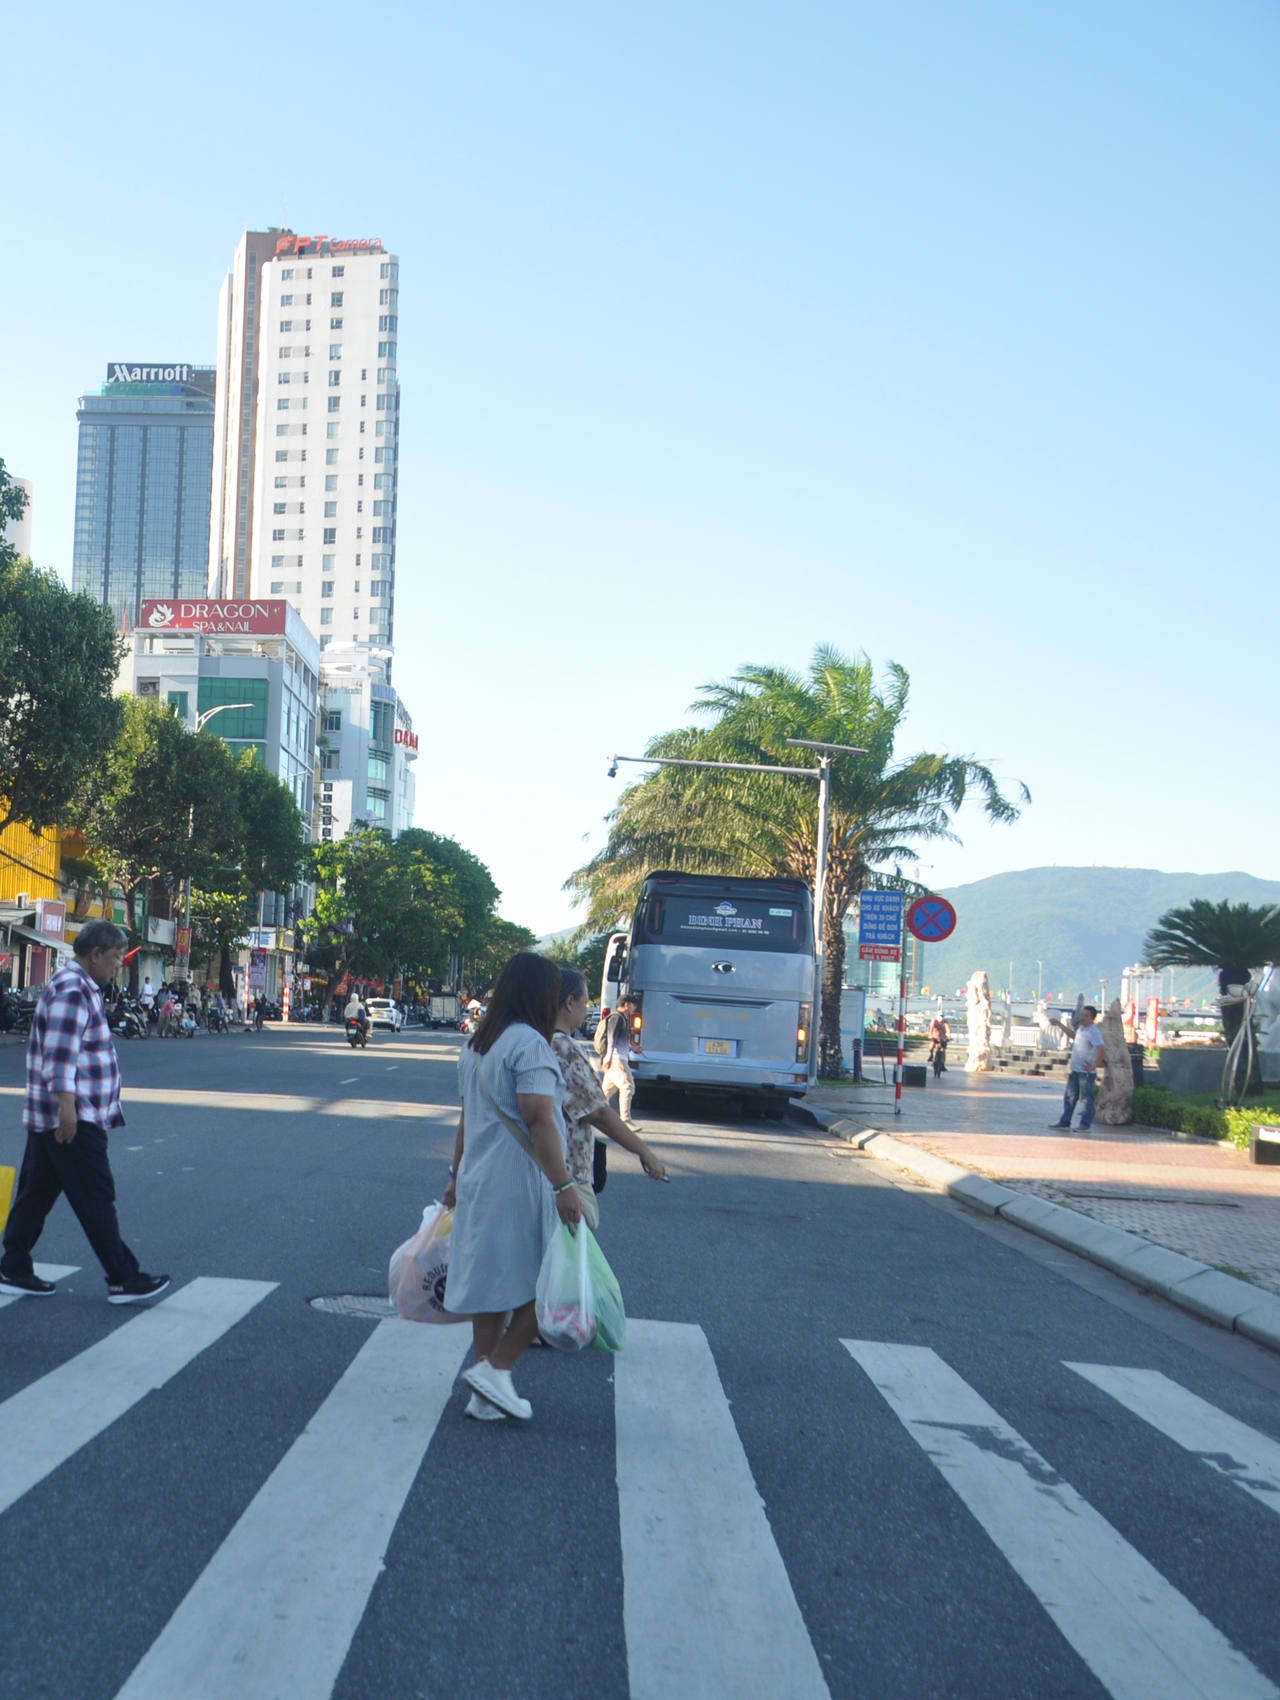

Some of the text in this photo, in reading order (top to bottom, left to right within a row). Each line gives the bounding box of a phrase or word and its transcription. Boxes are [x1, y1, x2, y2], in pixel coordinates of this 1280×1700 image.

[276, 235, 382, 254] FPT Camera
[108, 364, 189, 382] Marriott
[180, 603, 269, 618] DRAGON
[192, 620, 253, 632] SPA&NAIL
[724, 917, 762, 929] PHAN
